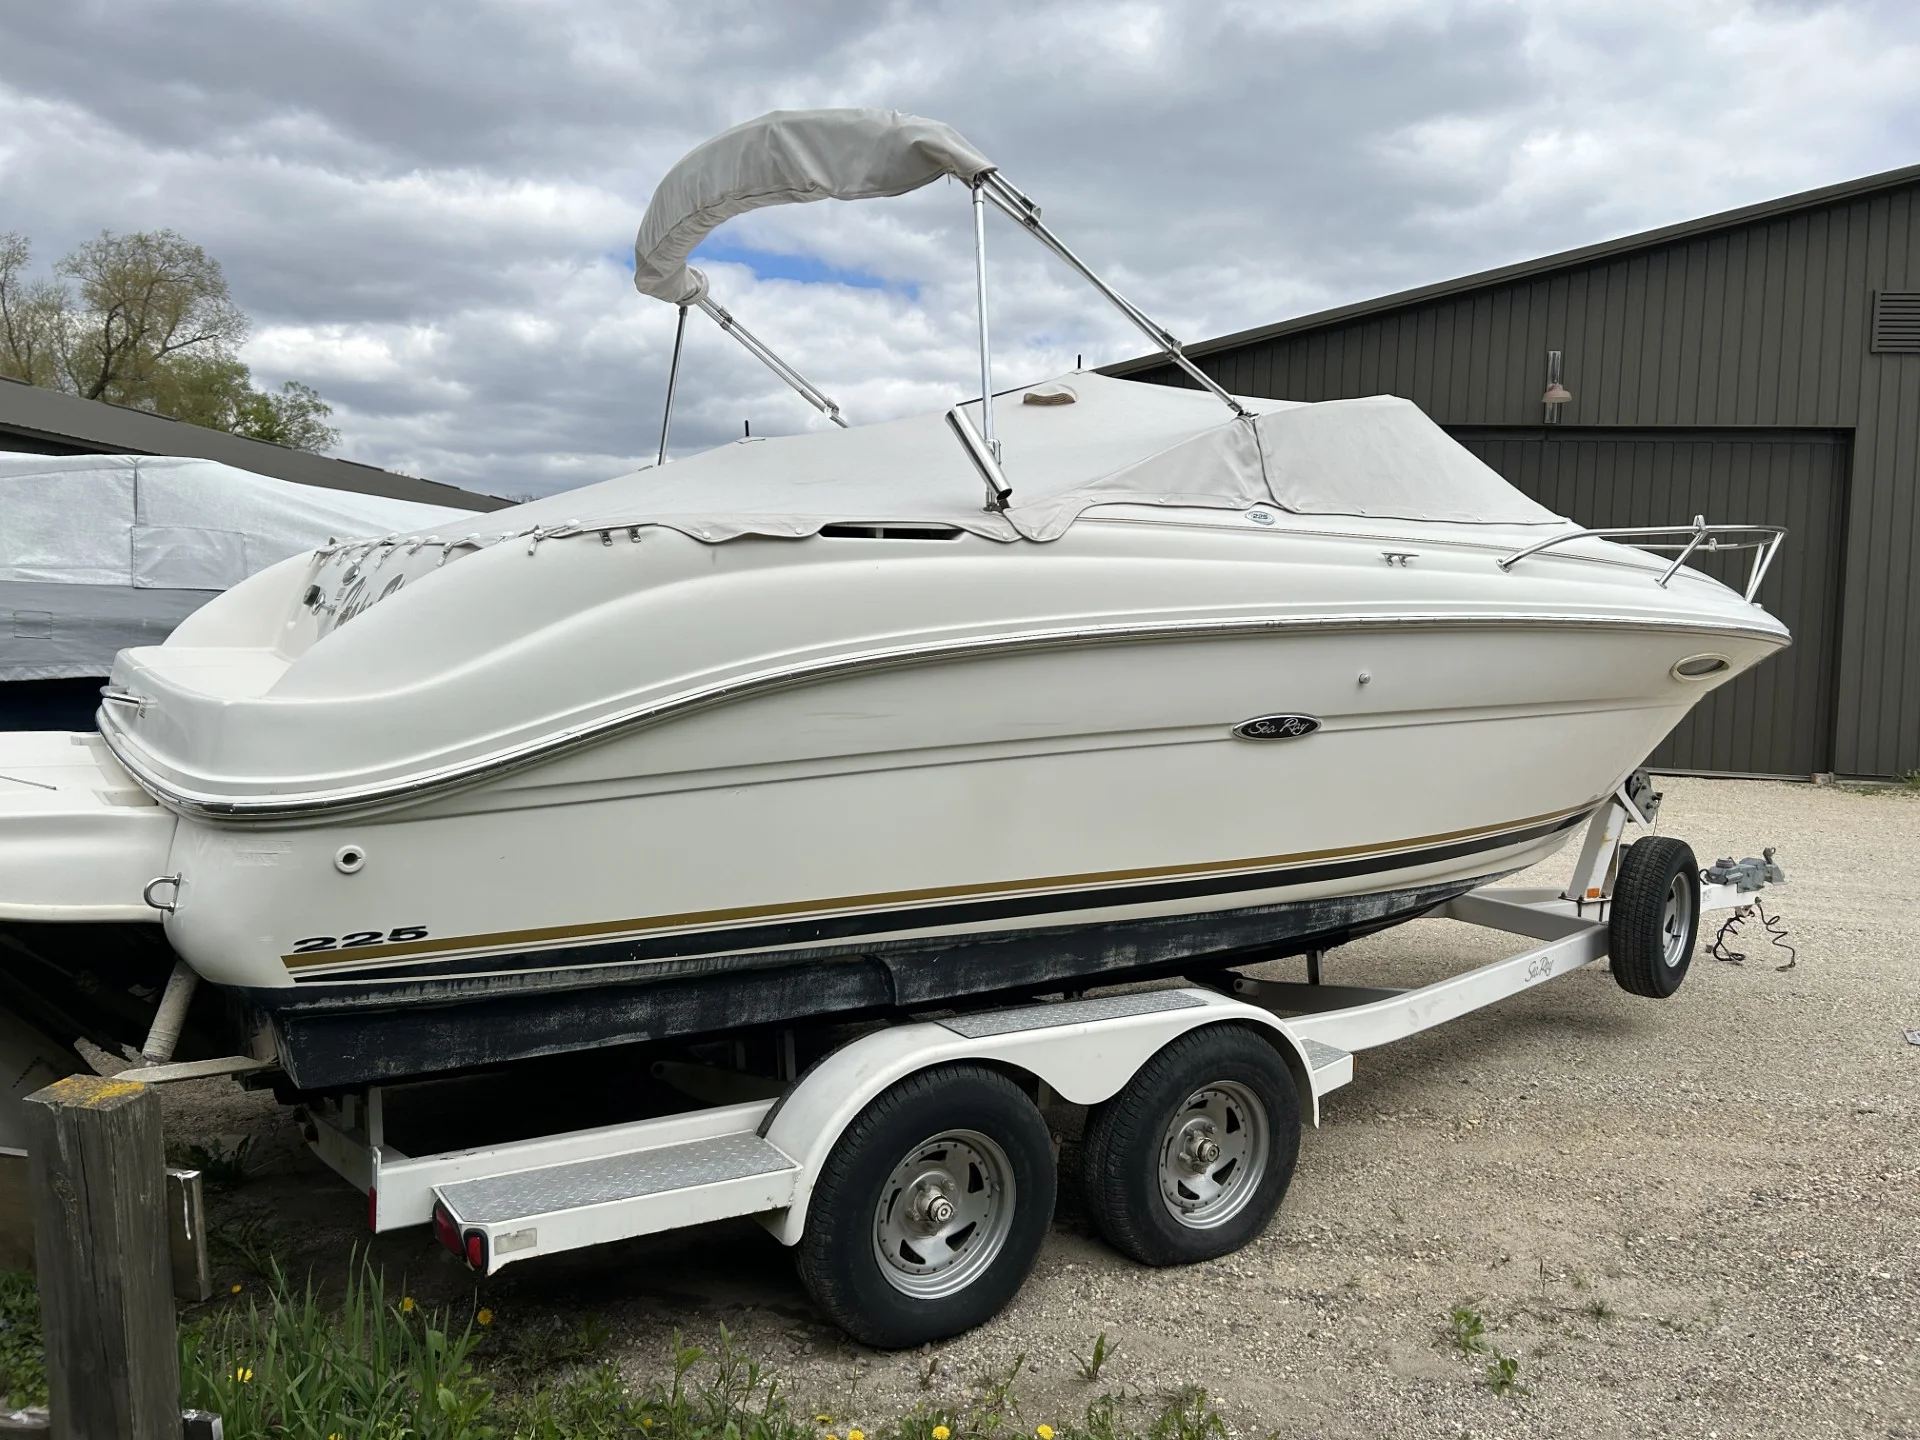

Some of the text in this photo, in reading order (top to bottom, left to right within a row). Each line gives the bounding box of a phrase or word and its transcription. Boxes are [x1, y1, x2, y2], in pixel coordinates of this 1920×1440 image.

[1248, 717, 1309, 735] Sea Ray
[293, 926, 428, 953] 225
[1524, 956, 1555, 982] Sea Ray
